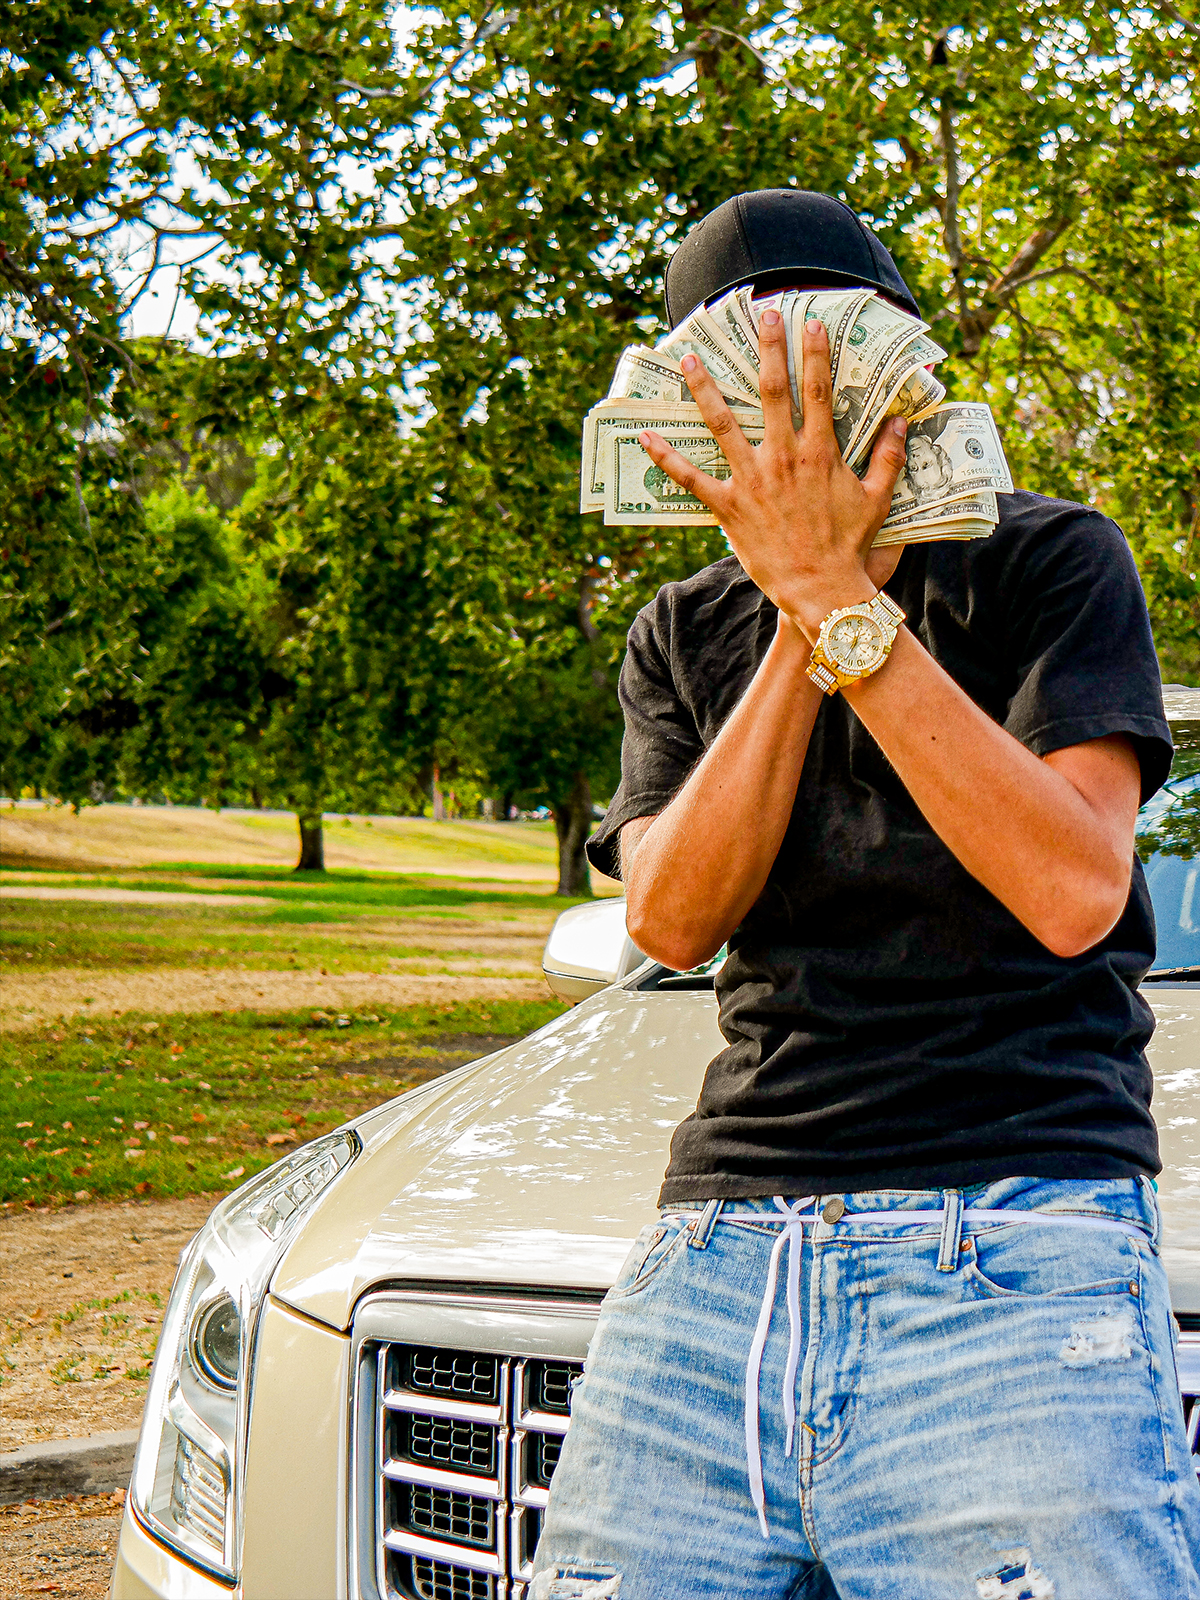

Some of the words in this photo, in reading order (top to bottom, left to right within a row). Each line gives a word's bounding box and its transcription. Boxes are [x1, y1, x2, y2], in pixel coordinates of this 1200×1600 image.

[633, 421, 669, 429] UNITED
[620, 501, 652, 511] 20
[661, 503, 710, 511] TWENT
